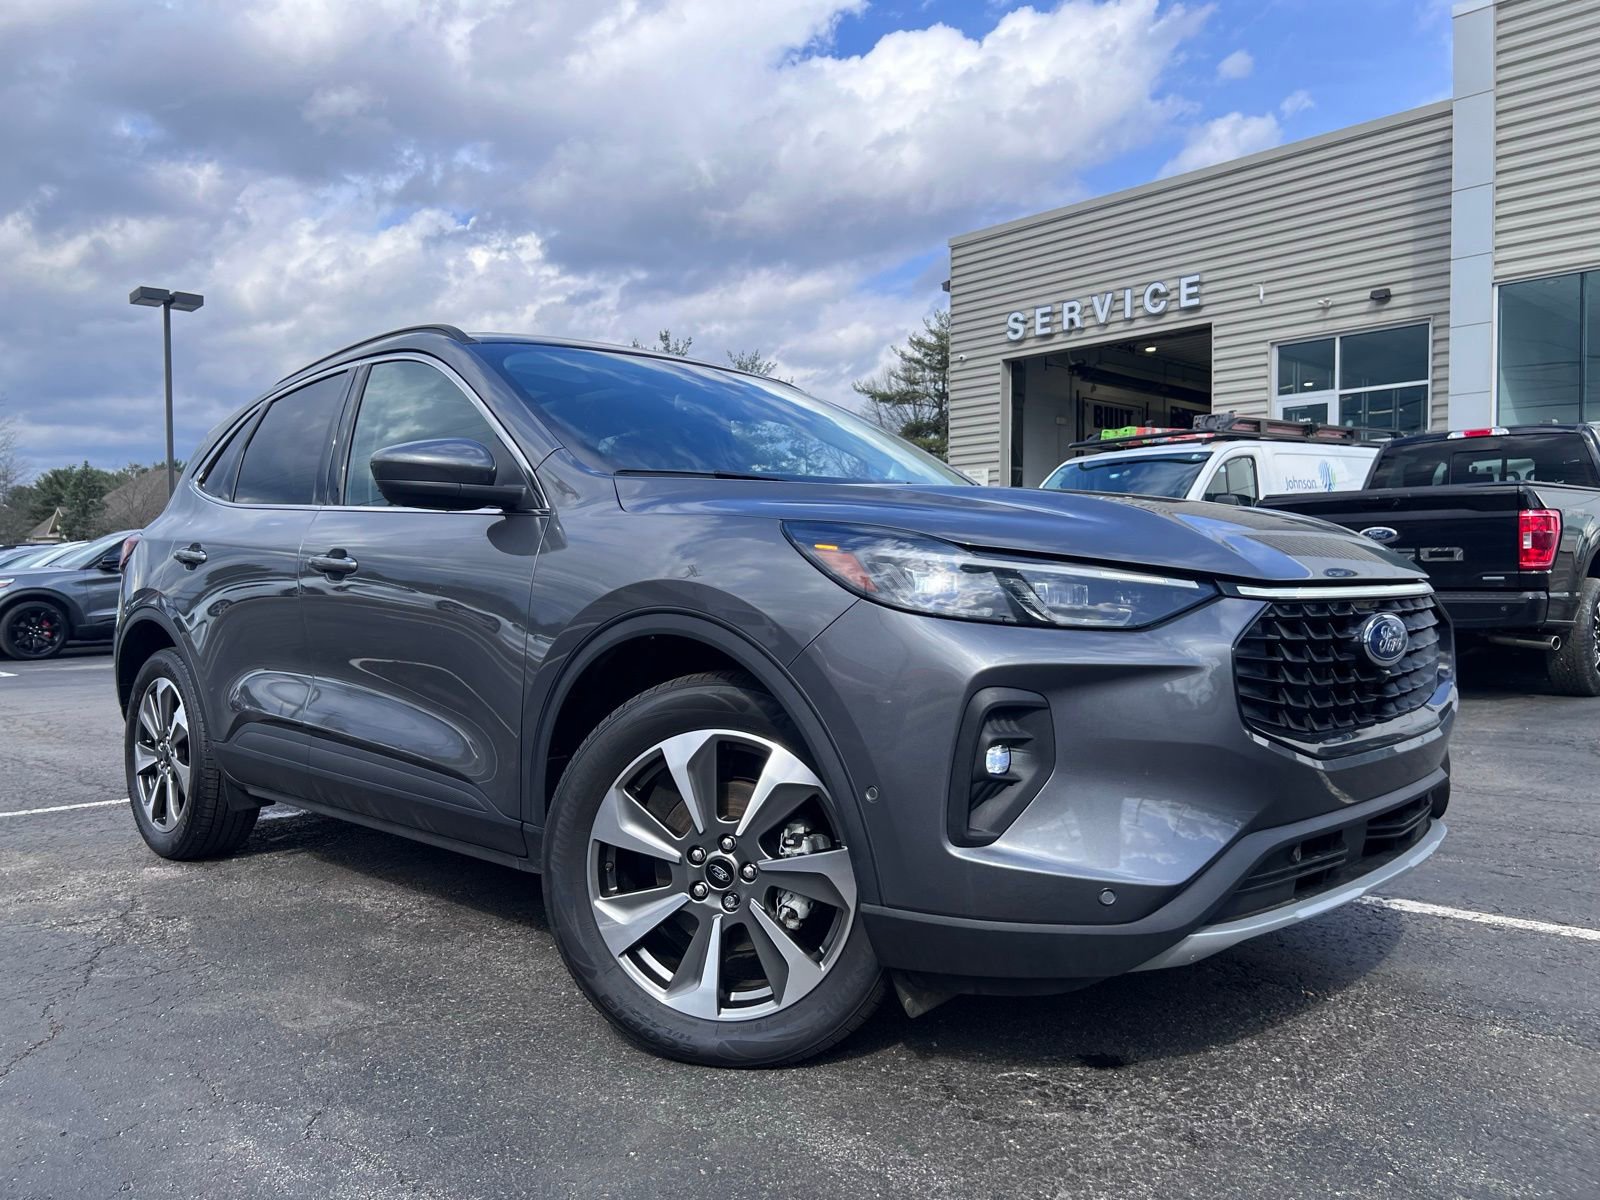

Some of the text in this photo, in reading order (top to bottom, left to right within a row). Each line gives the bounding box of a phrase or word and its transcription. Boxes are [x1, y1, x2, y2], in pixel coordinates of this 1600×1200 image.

[1006, 274, 1202, 342] SERVICE
[1093, 404, 1134, 428] BUILT
[1284, 475, 1317, 491] Johnson
[1378, 622, 1404, 654] Ford
